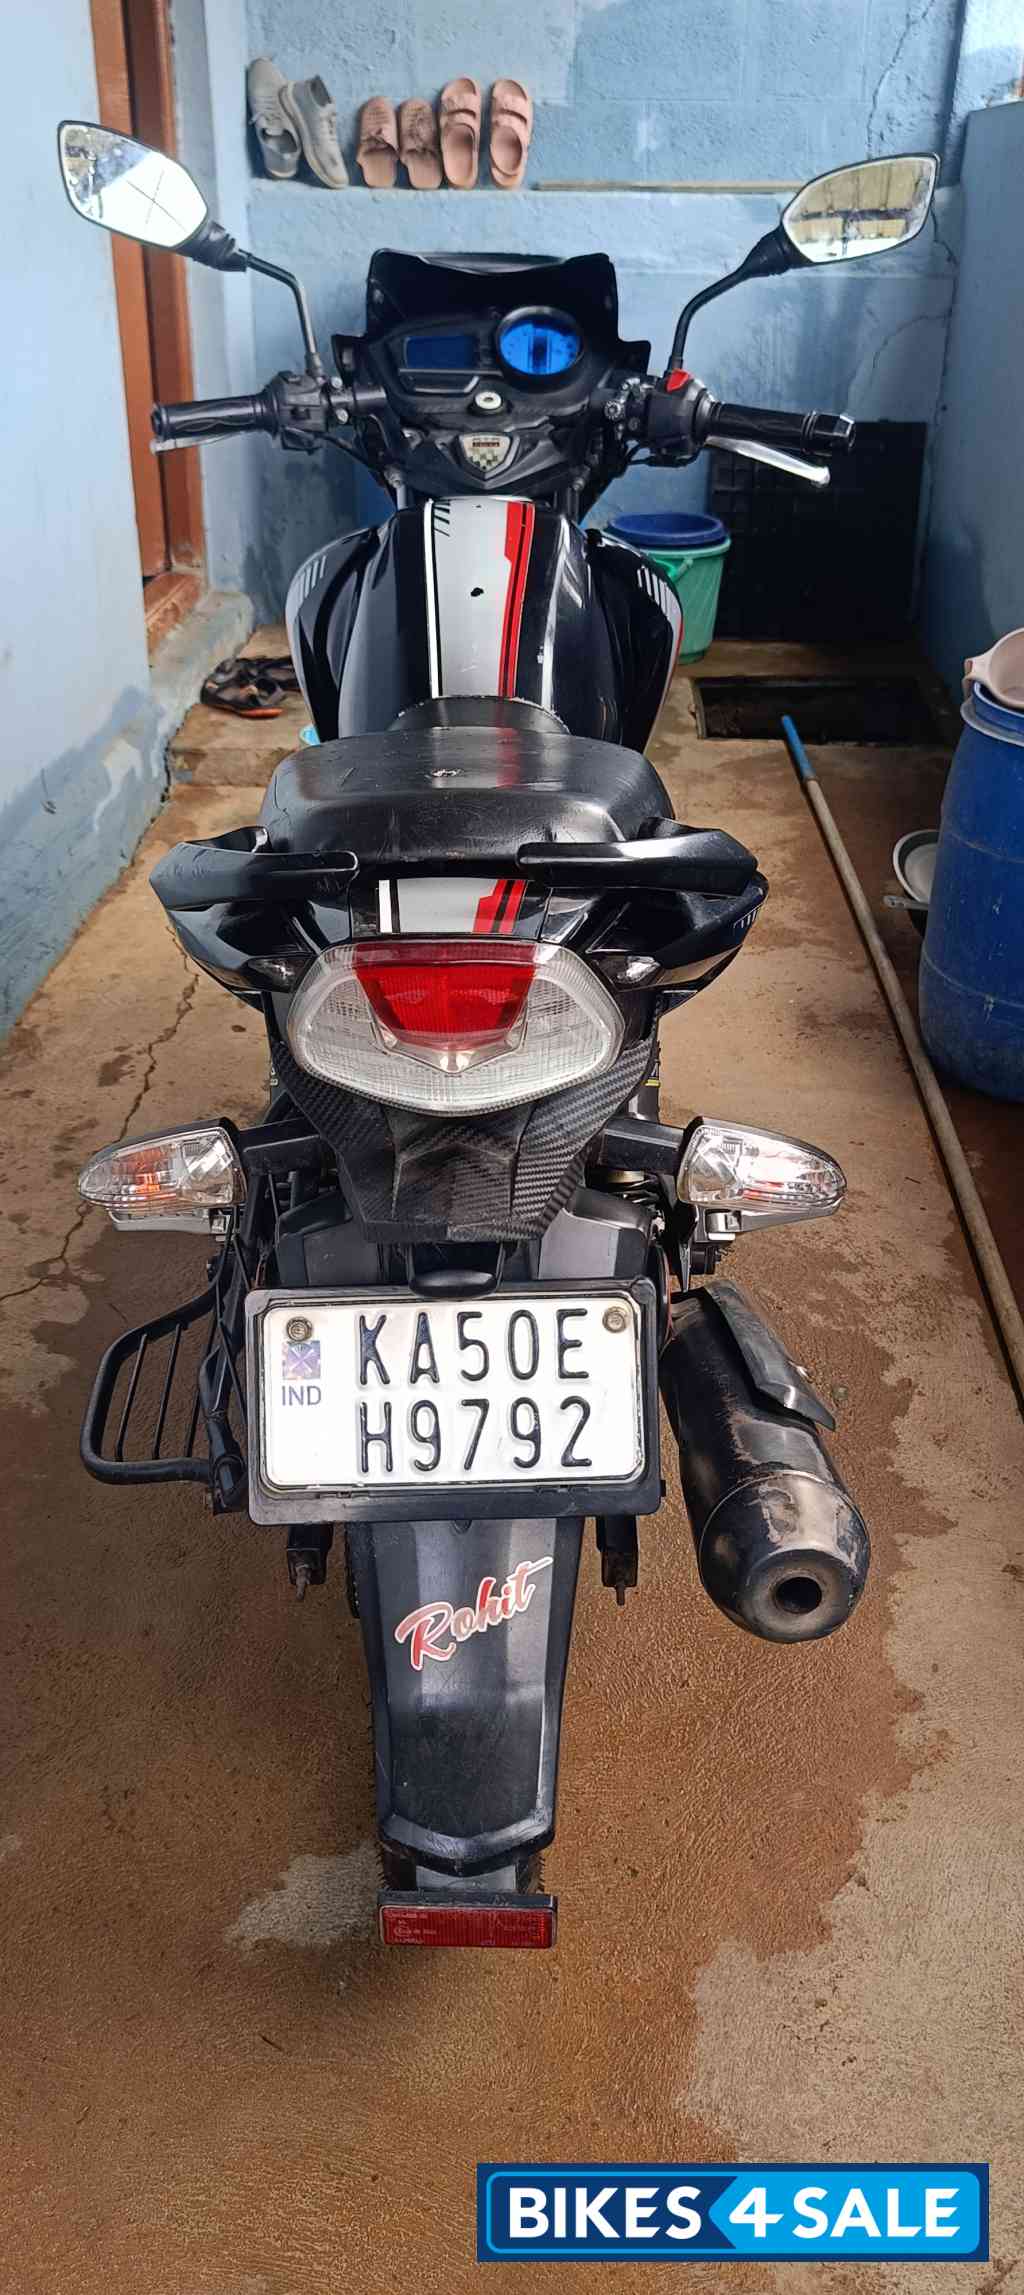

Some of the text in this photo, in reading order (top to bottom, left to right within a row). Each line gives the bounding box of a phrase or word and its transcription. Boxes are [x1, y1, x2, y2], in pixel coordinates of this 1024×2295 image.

[359, 1308, 589, 1386] KA50E
[281, 1386, 322, 1406] IND
[359, 1396, 593, 1473] H9792
[395, 1556, 553, 1671] Rohit
